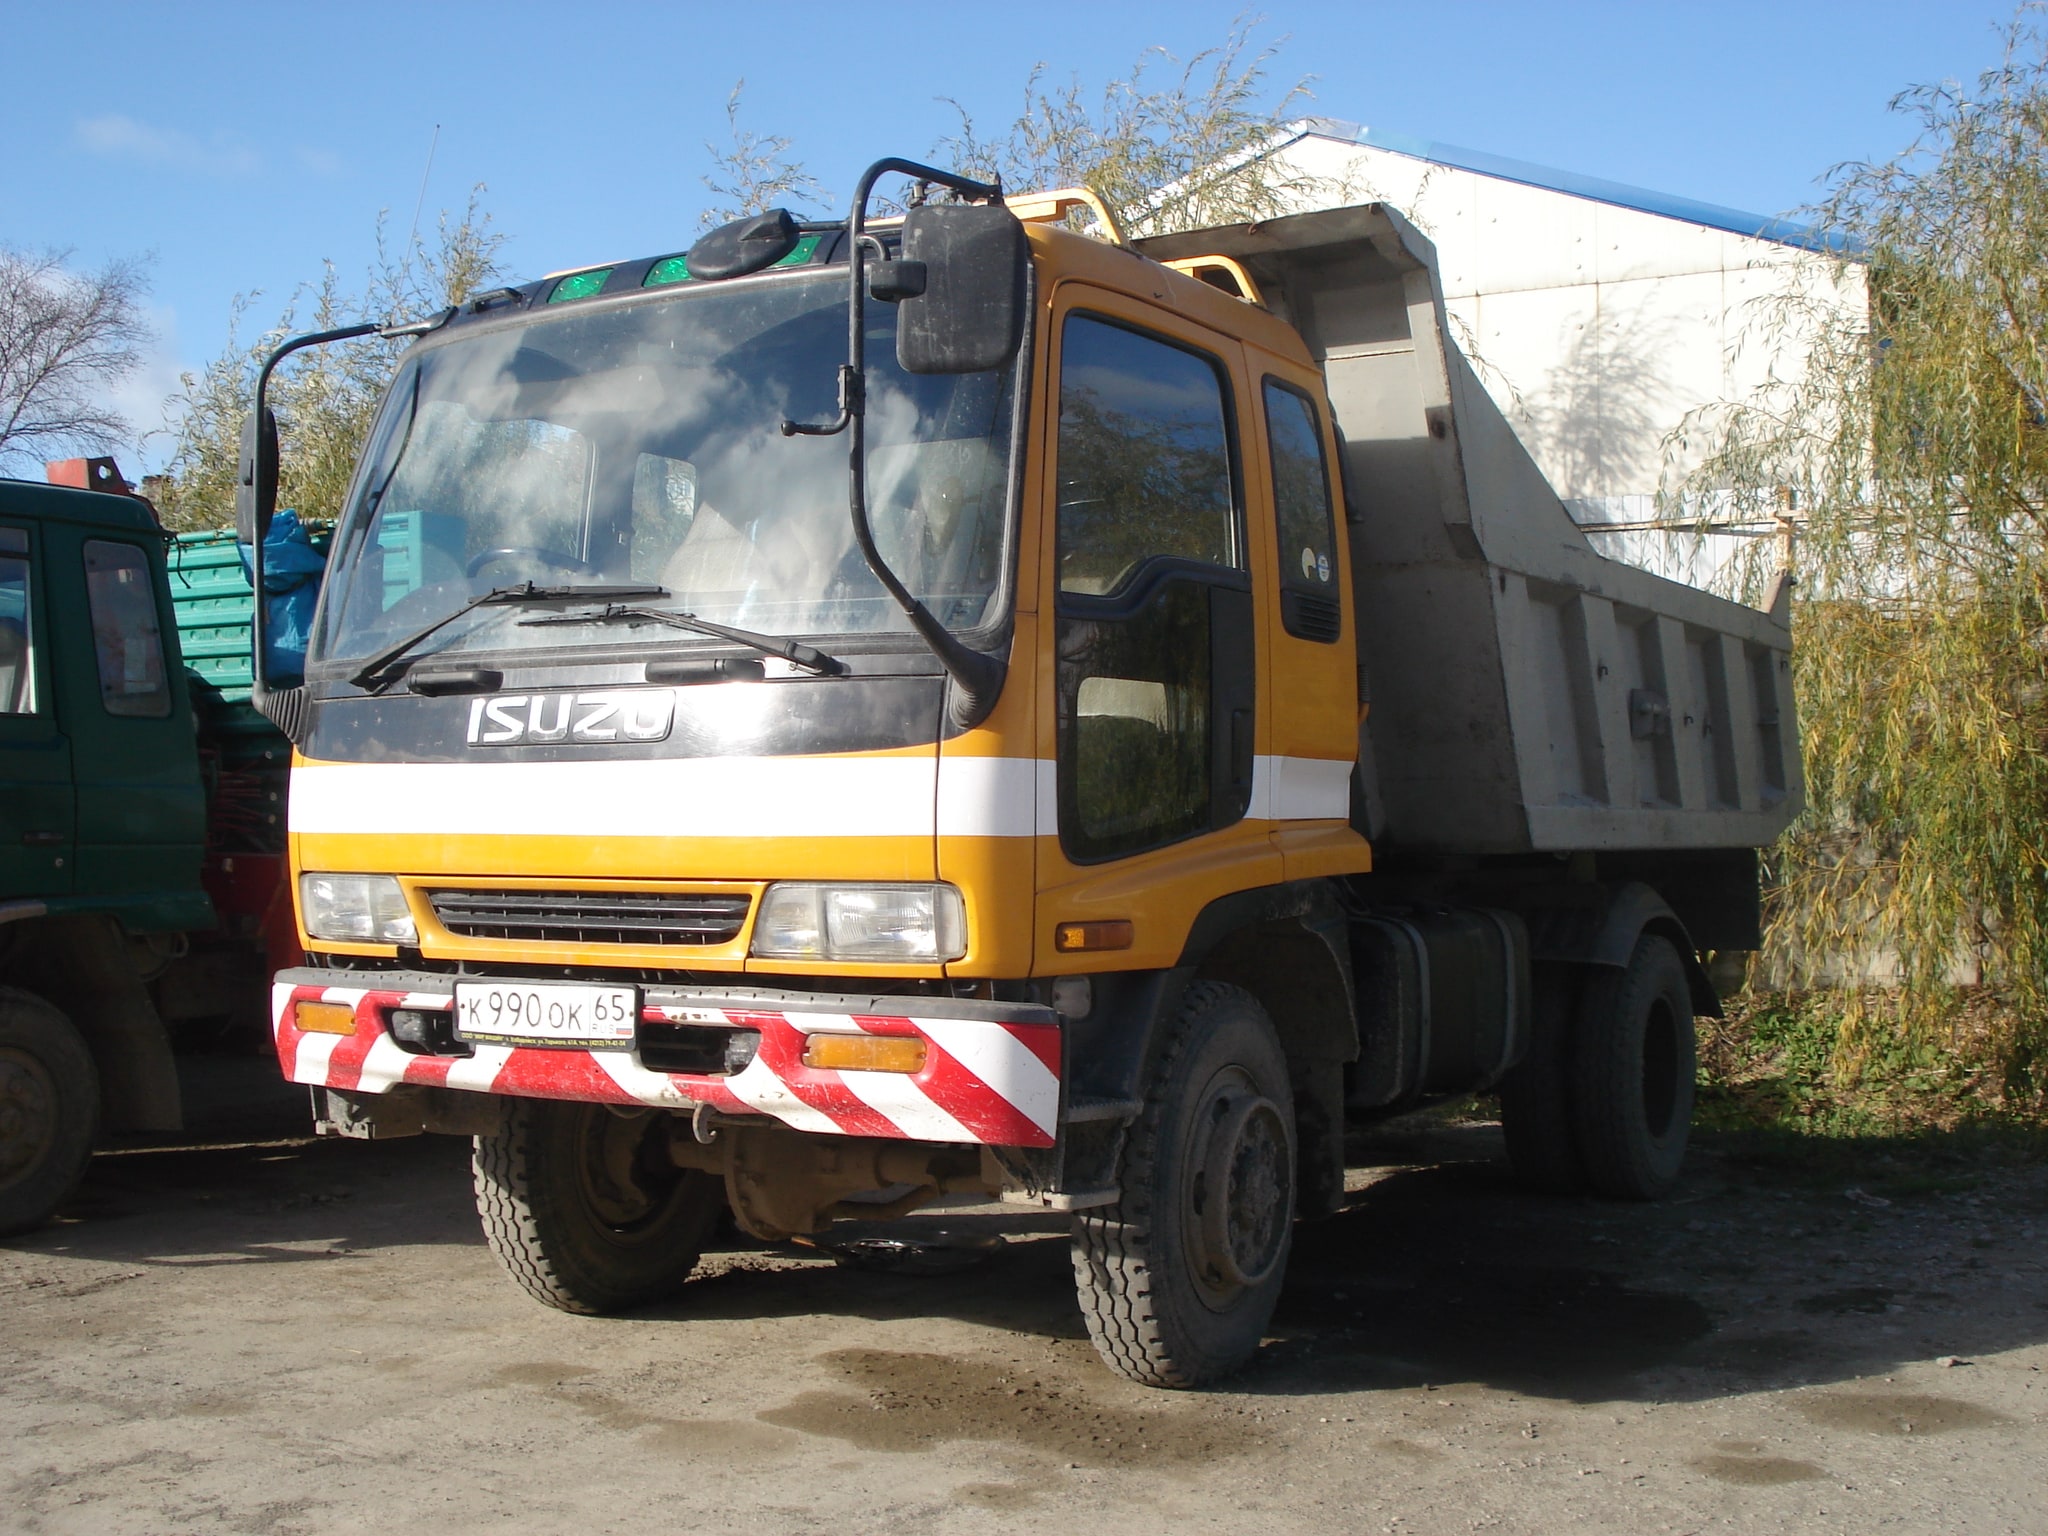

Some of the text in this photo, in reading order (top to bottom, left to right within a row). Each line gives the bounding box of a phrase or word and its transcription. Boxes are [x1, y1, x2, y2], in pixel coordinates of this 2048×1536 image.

[466, 688, 676, 745] ISUZU
[594, 994, 625, 1021] 65
[592, 1023, 614, 1034] RUS
